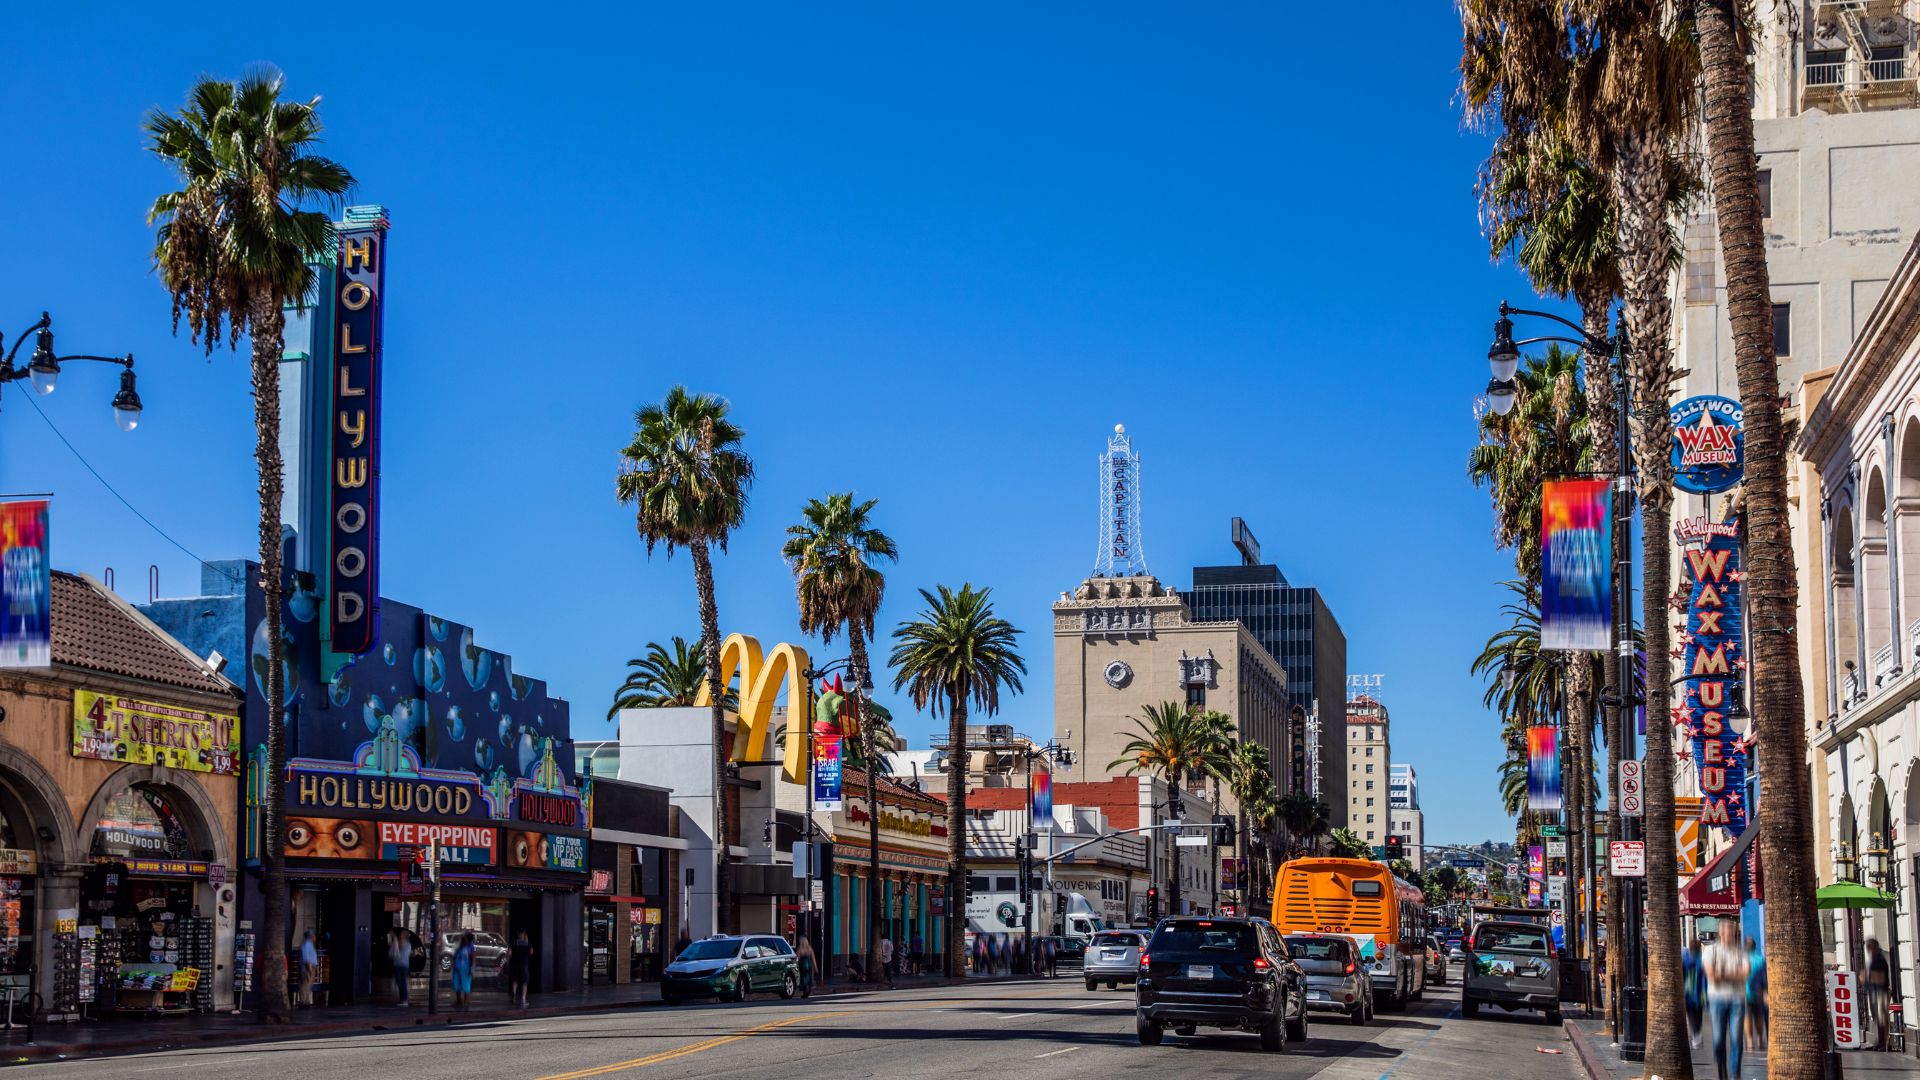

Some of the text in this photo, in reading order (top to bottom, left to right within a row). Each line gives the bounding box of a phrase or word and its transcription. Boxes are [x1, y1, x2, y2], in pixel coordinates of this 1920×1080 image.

[1670, 399, 1744, 431] OLLYWOO
[336, 236, 371, 624] HOLLYWOOD
[1676, 424, 1737, 450] WAX
[1681, 450, 1737, 464] MUSEUM
[1113, 468, 1127, 557] CAPITAN
[1676, 516, 1740, 544] Hollywood
[1686, 549, 1731, 635] WAX
[87, 696, 108, 730] 4
[111, 711, 201, 753] T-SHIRTS
[1691, 641, 1732, 825] MUSEUM
[82, 737, 102, 754] 1.99
[214, 755, 232, 771] 1.99
[818, 758, 839, 767] ISRAEL
[300, 774, 472, 815] HOLLYWOOD
[522, 793, 577, 825] HOLLYWOOD
[106, 831, 160, 849] HOLLYWOOD
[383, 823, 492, 847] EYE POPPING
[556, 837, 581, 846] GET YOUR
[425, 846, 469, 862] EAL!
[553, 844, 583, 860] VIP PASS
[560, 858, 576, 868] HERE
[1612, 849, 1643, 858] NO STOPPING
[162, 863, 187, 873] STARS
[211, 866, 226, 877] ATM
[1834, 973, 1853, 1043] TOURS
